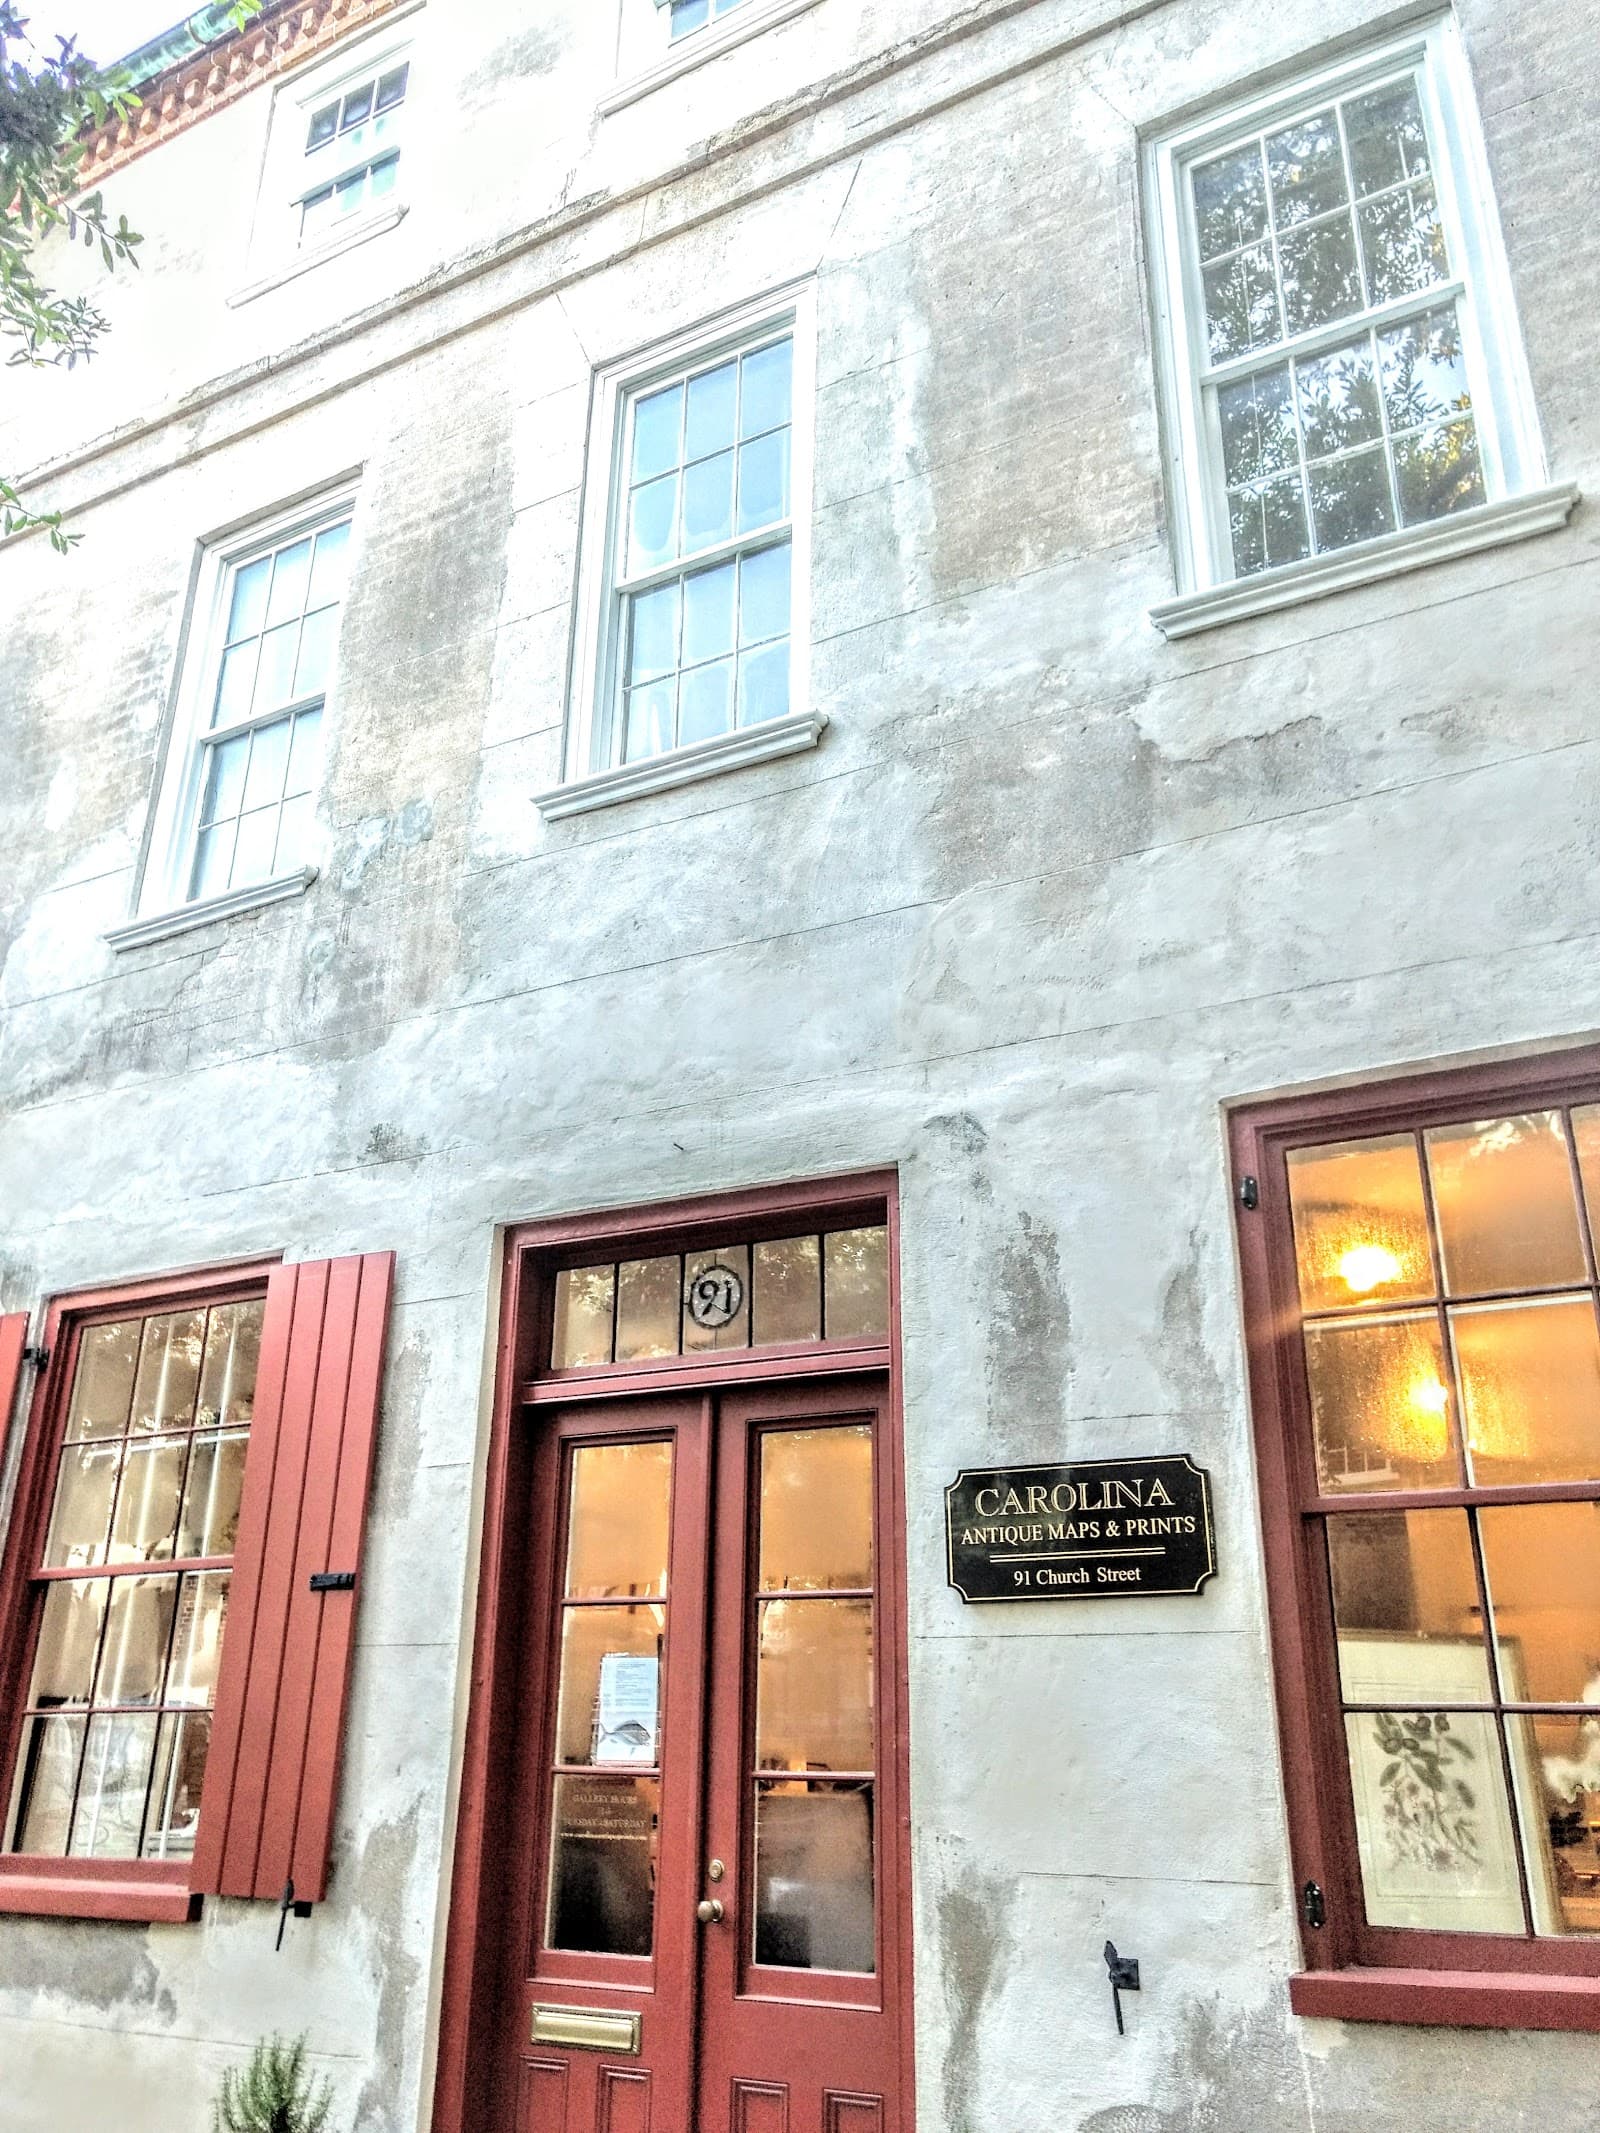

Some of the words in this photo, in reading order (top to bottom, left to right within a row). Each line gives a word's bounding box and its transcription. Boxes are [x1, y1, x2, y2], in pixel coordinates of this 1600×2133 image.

[699, 1280, 734, 1316] 91
[974, 1477, 1176, 1517] CAROLINA
[960, 1524, 1044, 1546] ANTIQUE
[1048, 1520, 1100, 1541] MAPS
[1105, 1520, 1121, 1538] &
[1125, 1515, 1197, 1536] PRINTS
[1013, 1569, 1031, 1586] 91
[1036, 1567, 1090, 1585] Church
[1096, 1566, 1142, 1583] Street
